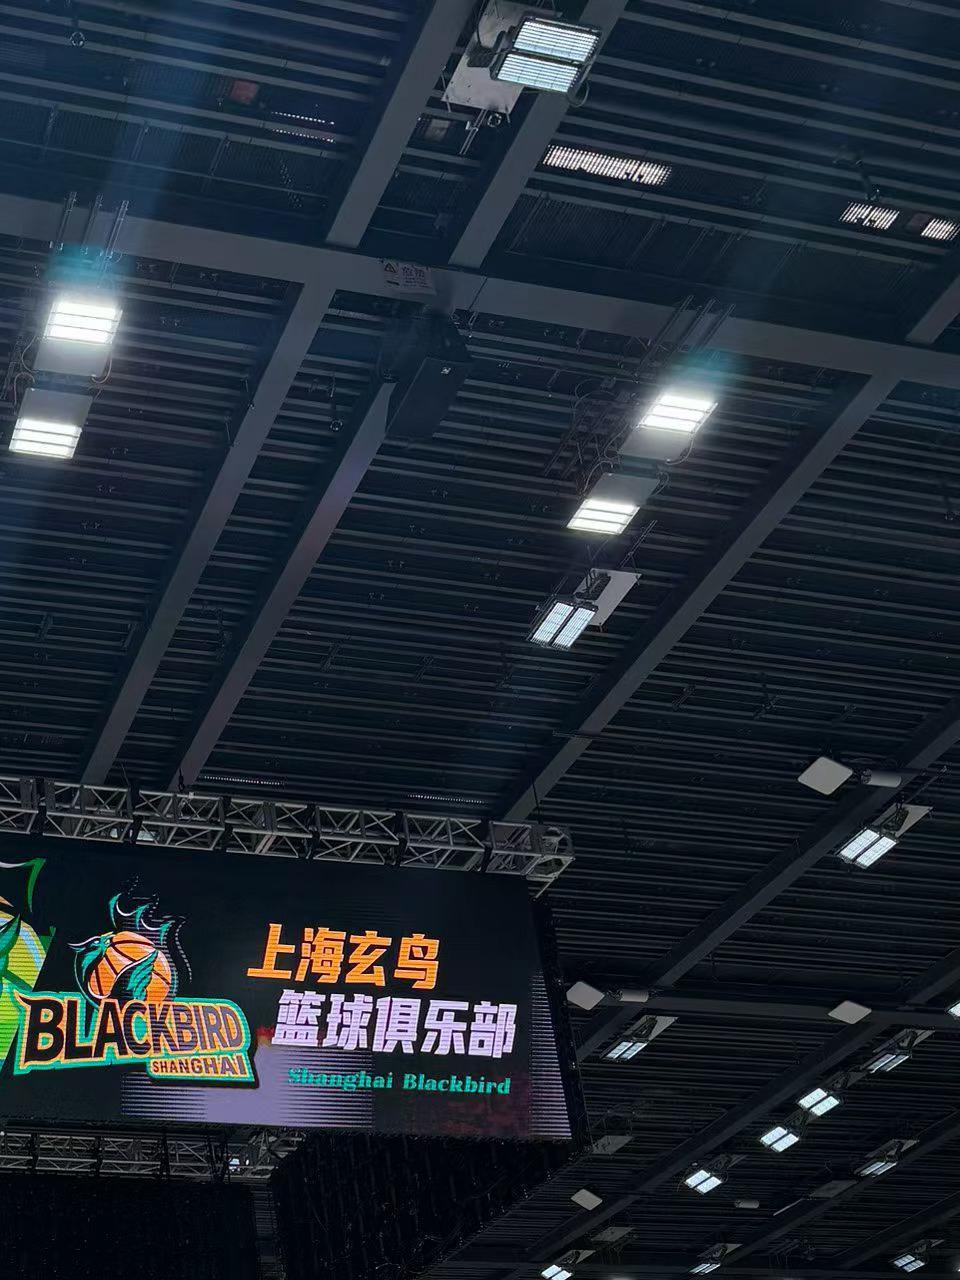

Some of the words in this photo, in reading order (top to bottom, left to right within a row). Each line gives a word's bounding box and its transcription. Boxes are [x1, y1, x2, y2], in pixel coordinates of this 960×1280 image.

[246, 922, 440, 990] 上海玄鸟
[15, 989, 248, 1070] BLACKBIRD
[271, 989, 518, 1059] 篮球俱乐部
[151, 1053, 249, 1077] SHANGHAI
[287, 1065, 393, 1092] Shanghai
[402, 1071, 512, 1096] Blackbird
